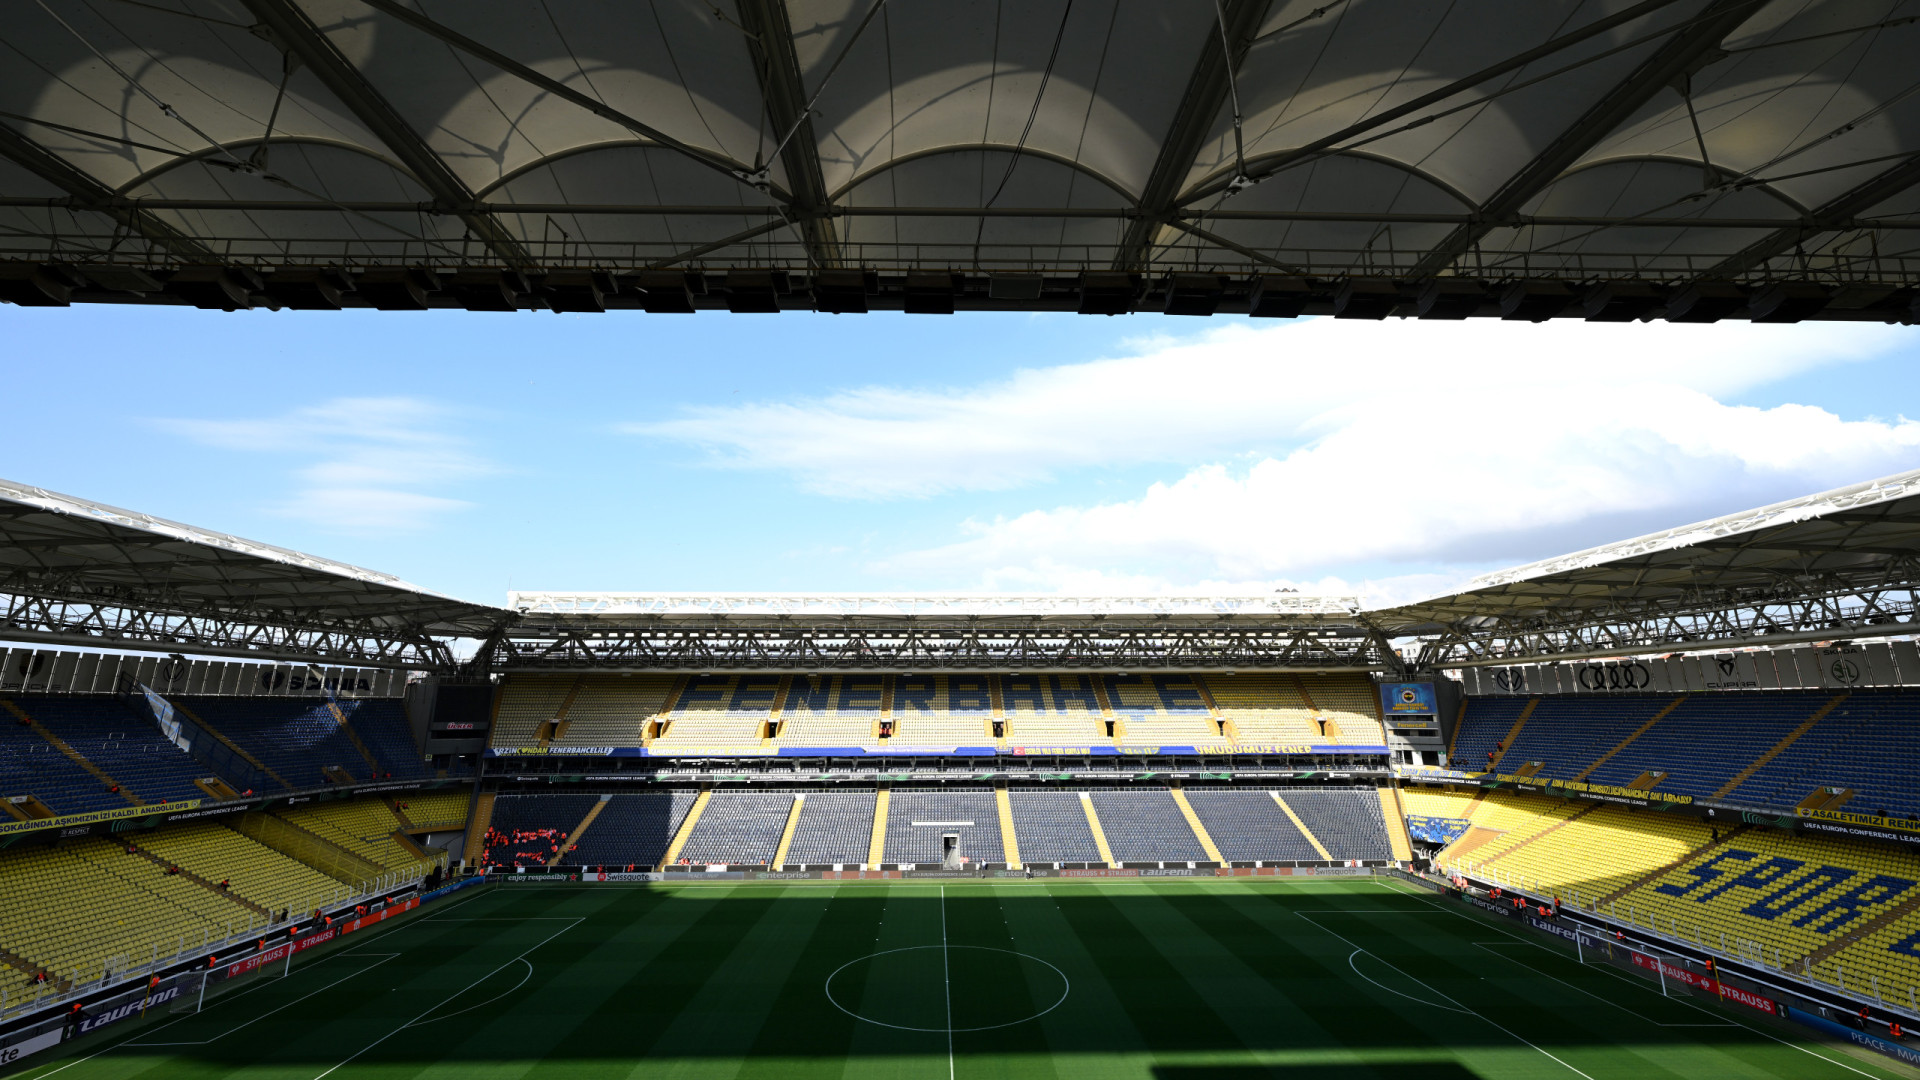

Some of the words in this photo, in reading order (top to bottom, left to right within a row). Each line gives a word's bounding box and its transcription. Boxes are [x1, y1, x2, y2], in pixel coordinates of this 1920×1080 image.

[672, 674, 1209, 721] FENERBAHÇE
[0, 821, 53, 832] SOKAĞINDA
[54, 814, 98, 827] AŞKIMIZIN
[100, 812, 110, 820] İZİ
[140, 803, 174, 814] ANADOLU
[175, 802, 188, 810] GFB
[201, 808, 231, 816] CONFERENCE
[1812, 810, 1884, 825] ASALETİMİZİ
[1888, 818, 1920, 831] RENK
[1803, 822, 1821, 830] UEFA
[1822, 824, 1848, 834] EUROPA
[1849, 828, 1898, 840] CONFERENCE
[1899, 835, 1920, 843] LEAG
[758, 871, 810, 879] enterprise
[1315, 868, 1357, 876] Swissquote
[1655, 848, 1918, 935] SPOR
[1462, 892, 1509, 916] enterprise
[302, 930, 333, 948] STRAUSS
[246, 949, 283, 969] STRAUSS
[1650, 961, 1692, 983] STRAUSS
[1719, 984, 1771, 1011] STRAUSS
[1851, 1031, 1886, 1052] PEACE
